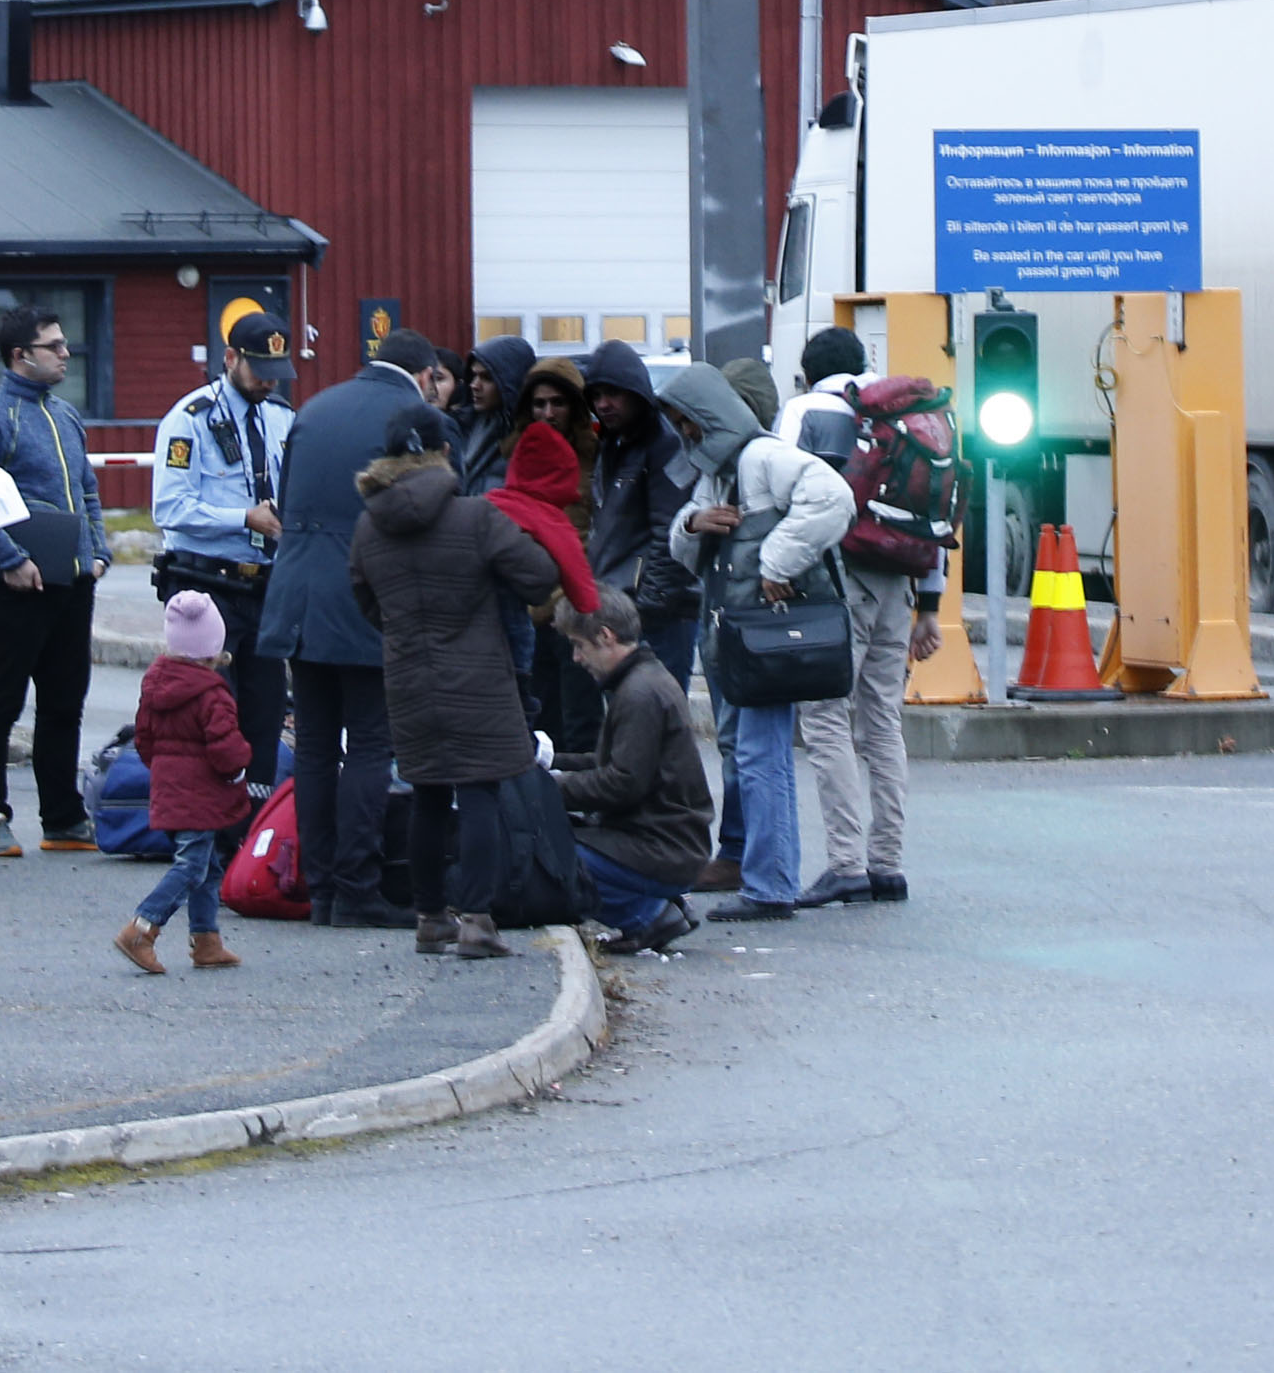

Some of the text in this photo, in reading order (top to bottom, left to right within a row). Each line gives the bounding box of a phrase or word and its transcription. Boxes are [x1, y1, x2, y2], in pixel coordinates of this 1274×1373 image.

[939, 143, 1025, 160] Информация
[1037, 143, 1111, 160] Informasjon
[1123, 143, 1194, 157] Information
[946, 175, 1024, 189] Оставайтесь
[1036, 178, 1082, 188] машине
[1084, 178, 1113, 188] пока
[1115, 178, 1130, 188] не
[1047, 193, 1074, 203] свет
[1077, 192, 1143, 205] светофора
[946, 220, 962, 233] Bli
[964, 220, 1009, 233] sittende
[1017, 220, 1044, 233] bilen
[1058, 221, 1073, 232] de
[1075, 221, 1095, 232] har
[1097, 221, 1139, 235] passert
[1172, 220, 1190, 235] lys
[973, 249, 1164, 264] Be seated in the car until you have
[1017, 265, 1120, 280] passed green light
